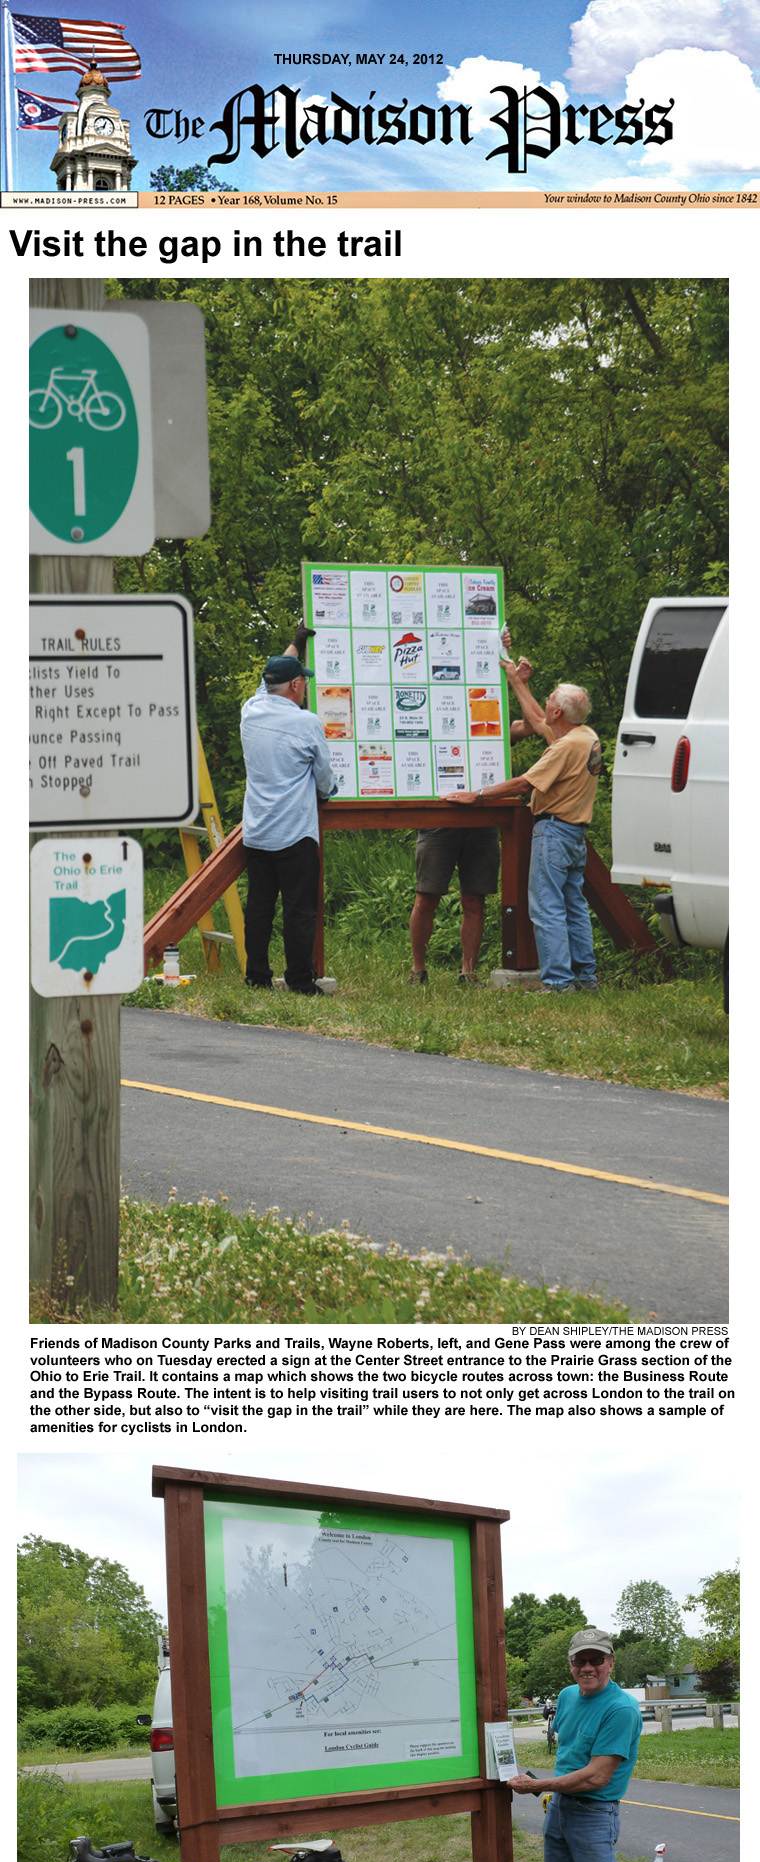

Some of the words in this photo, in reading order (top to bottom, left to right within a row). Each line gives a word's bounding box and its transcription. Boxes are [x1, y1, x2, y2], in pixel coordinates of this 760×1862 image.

[66, 446, 86, 516] 1
[41, 638, 75, 651] TRAIL
[81, 637, 121, 651] RULES
[394, 645, 423, 662] Pizza
[400, 655, 420, 667] Hut
[66, 666, 98, 679] Yield
[106, 665, 120, 678] To
[65, 685, 94, 698] Uses
[35, 706, 69, 723] Right
[77, 704, 121, 721] Except
[128, 703, 141, 717] To
[149, 703, 179, 717] Pass
[70, 731, 121, 746] Passing
[39, 756, 56, 769] Off
[65, 755, 103, 768] Paved
[110, 754, 140, 767] Trail
[41, 774, 93, 791] Stopped
[53, 852, 76, 862] The
[53, 865, 81, 876] Ohio
[100, 865, 122, 875] Erie
[54, 881, 78, 890] Trail
[345, 1743, 362, 1751] Cyclist
[363, 1742, 379, 1750] Guide
